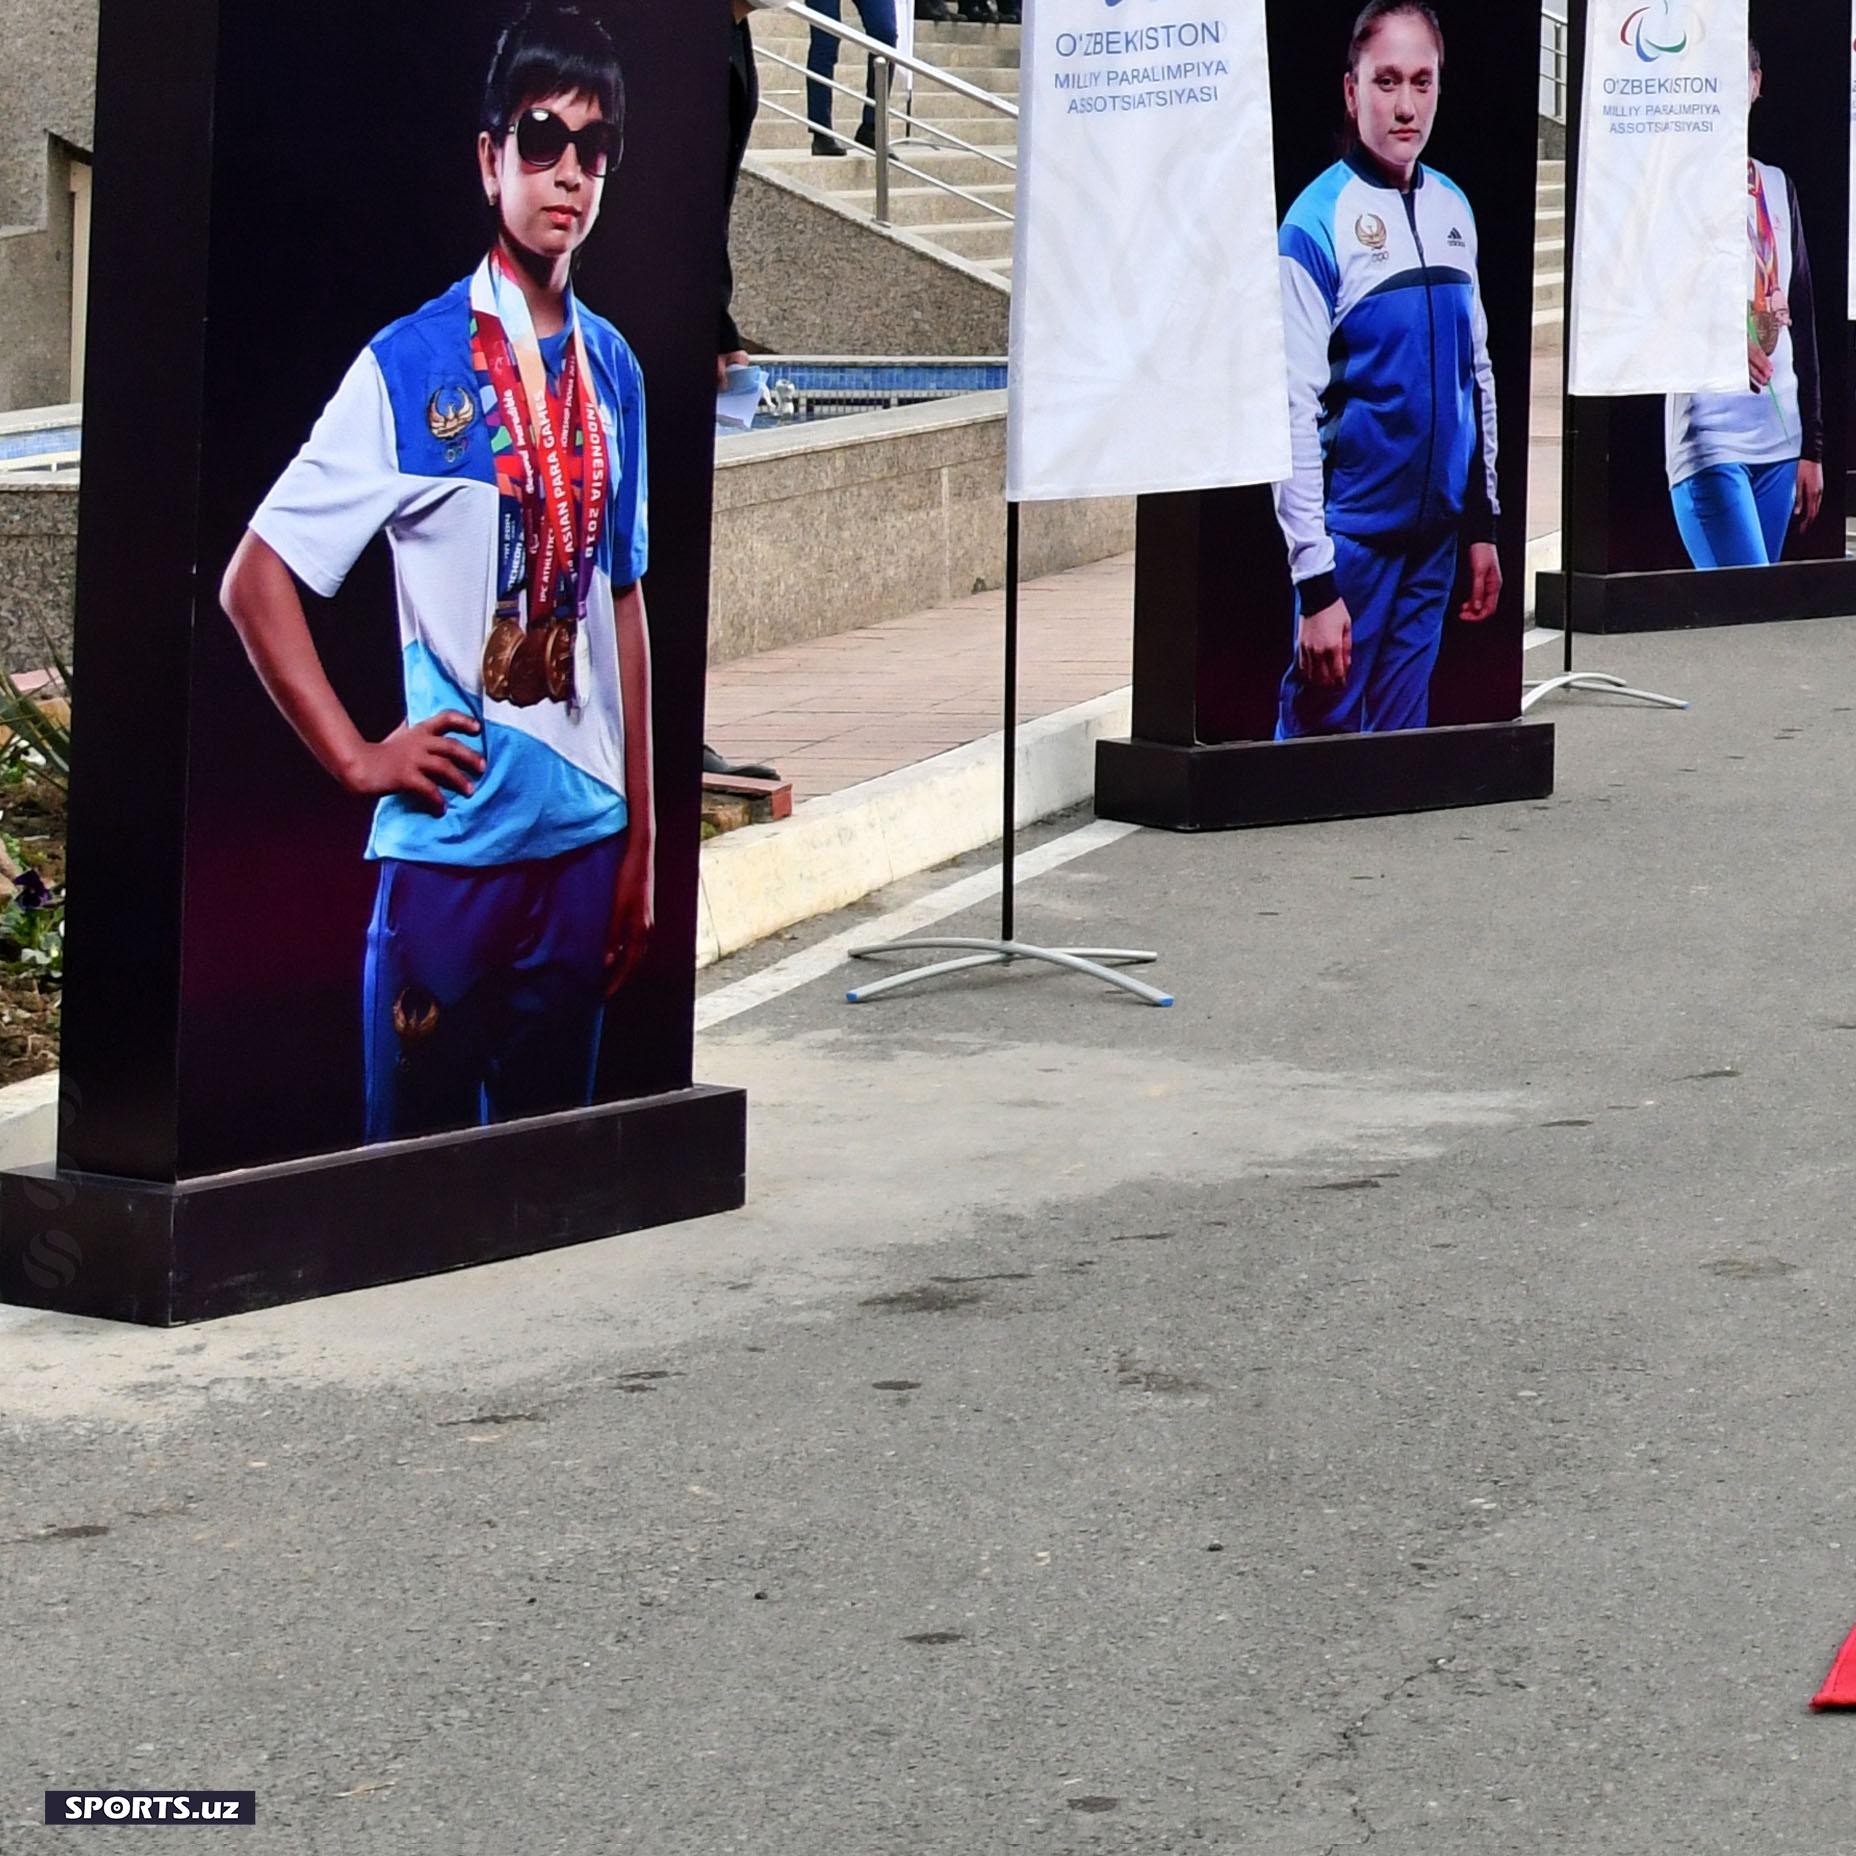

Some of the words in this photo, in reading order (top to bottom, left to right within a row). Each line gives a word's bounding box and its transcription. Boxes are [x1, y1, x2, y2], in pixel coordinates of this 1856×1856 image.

[1107, 60, 1229, 87] PARALIMPIYA
[1067, 86, 1218, 114] ASSOTSIATSIYASI
[546, 450, 567, 499] PARA
[585, 401, 605, 502] INDONESIA
[557, 500, 575, 554] ASIAN
